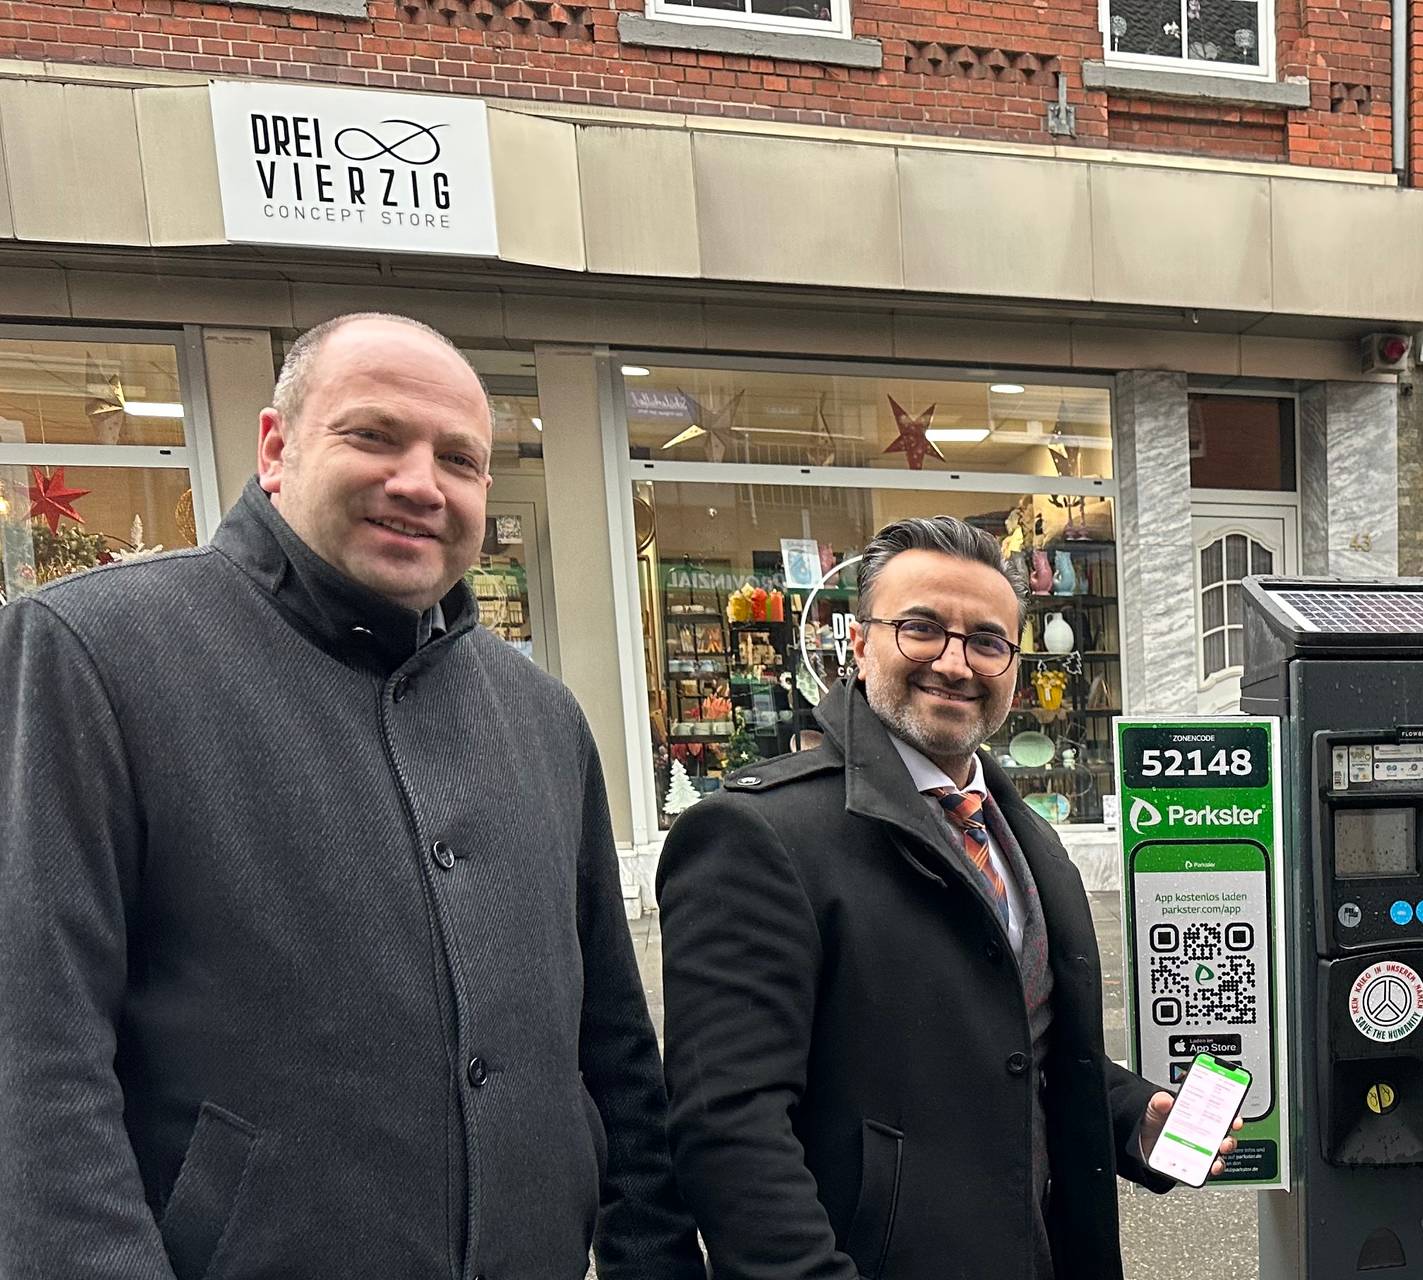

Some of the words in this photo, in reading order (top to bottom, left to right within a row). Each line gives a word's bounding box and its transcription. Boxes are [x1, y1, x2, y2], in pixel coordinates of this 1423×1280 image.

[251, 113, 323, 158] DREI
[256, 159, 451, 210] VIERZIG
[263, 204, 366, 224] CONCEPT
[381, 211, 451, 229] STORE
[1141, 748, 1253, 777] 52148
[1168, 804, 1263, 826] Parkster
[1155, 893, 1173, 904] App
[1175, 892, 1220, 902] kostenlos
[1221, 892, 1248, 901] laden
[1161, 904, 1242, 916] parkster.com/app
[1373, 966, 1382, 975] IN
[1354, 972, 1372, 993] KRIEG
[1351, 997, 1359, 1015] KEIN
[1355, 1016, 1372, 1035] SAVE
[1372, 1029, 1386, 1040] THE
[1388, 1011, 1421, 1039] HUMANITY
[1189, 1044, 1210, 1053] App
[1211, 1043, 1237, 1052] Store
